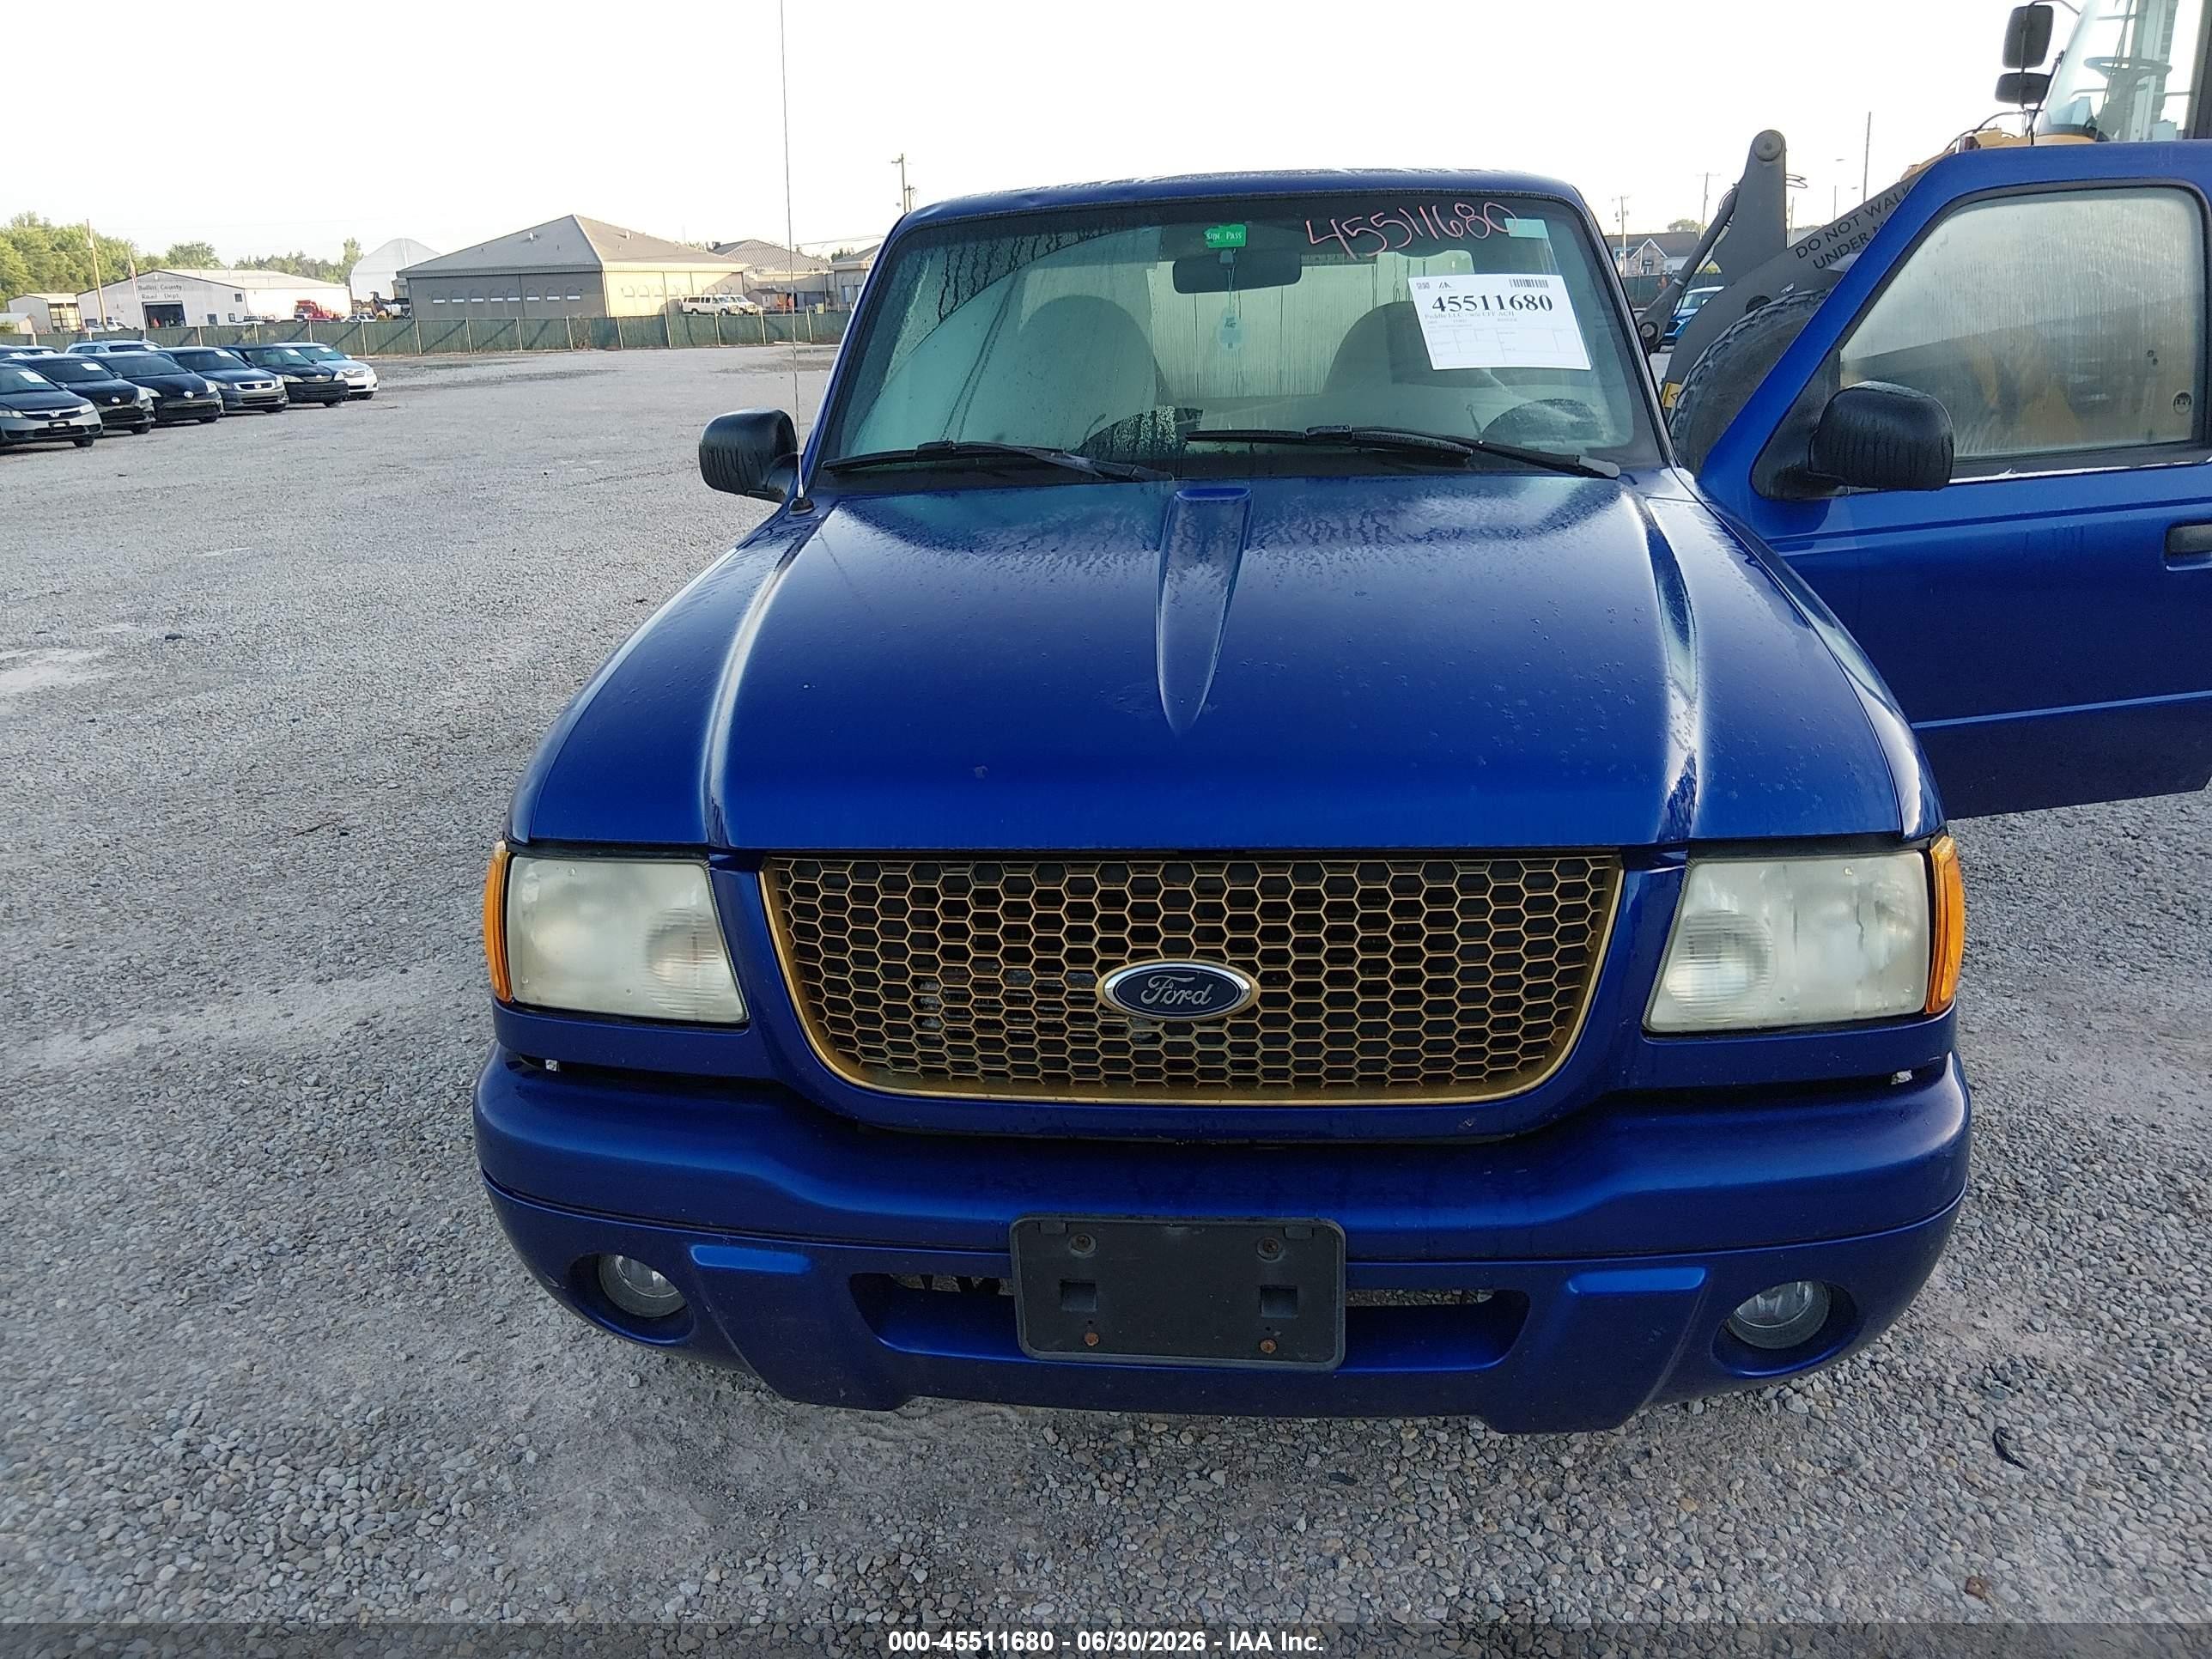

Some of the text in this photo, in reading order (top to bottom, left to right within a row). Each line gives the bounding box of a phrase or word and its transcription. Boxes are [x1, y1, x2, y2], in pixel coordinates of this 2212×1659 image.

[1305, 201, 1518, 260] 45511680
[1796, 239, 1821, 259] DO
[1825, 214, 1860, 242] NOT
[1813, 232, 1870, 270] UNDER
[1431, 294, 1553, 313] 45511680
[1140, 975, 1213, 1006] Ford
